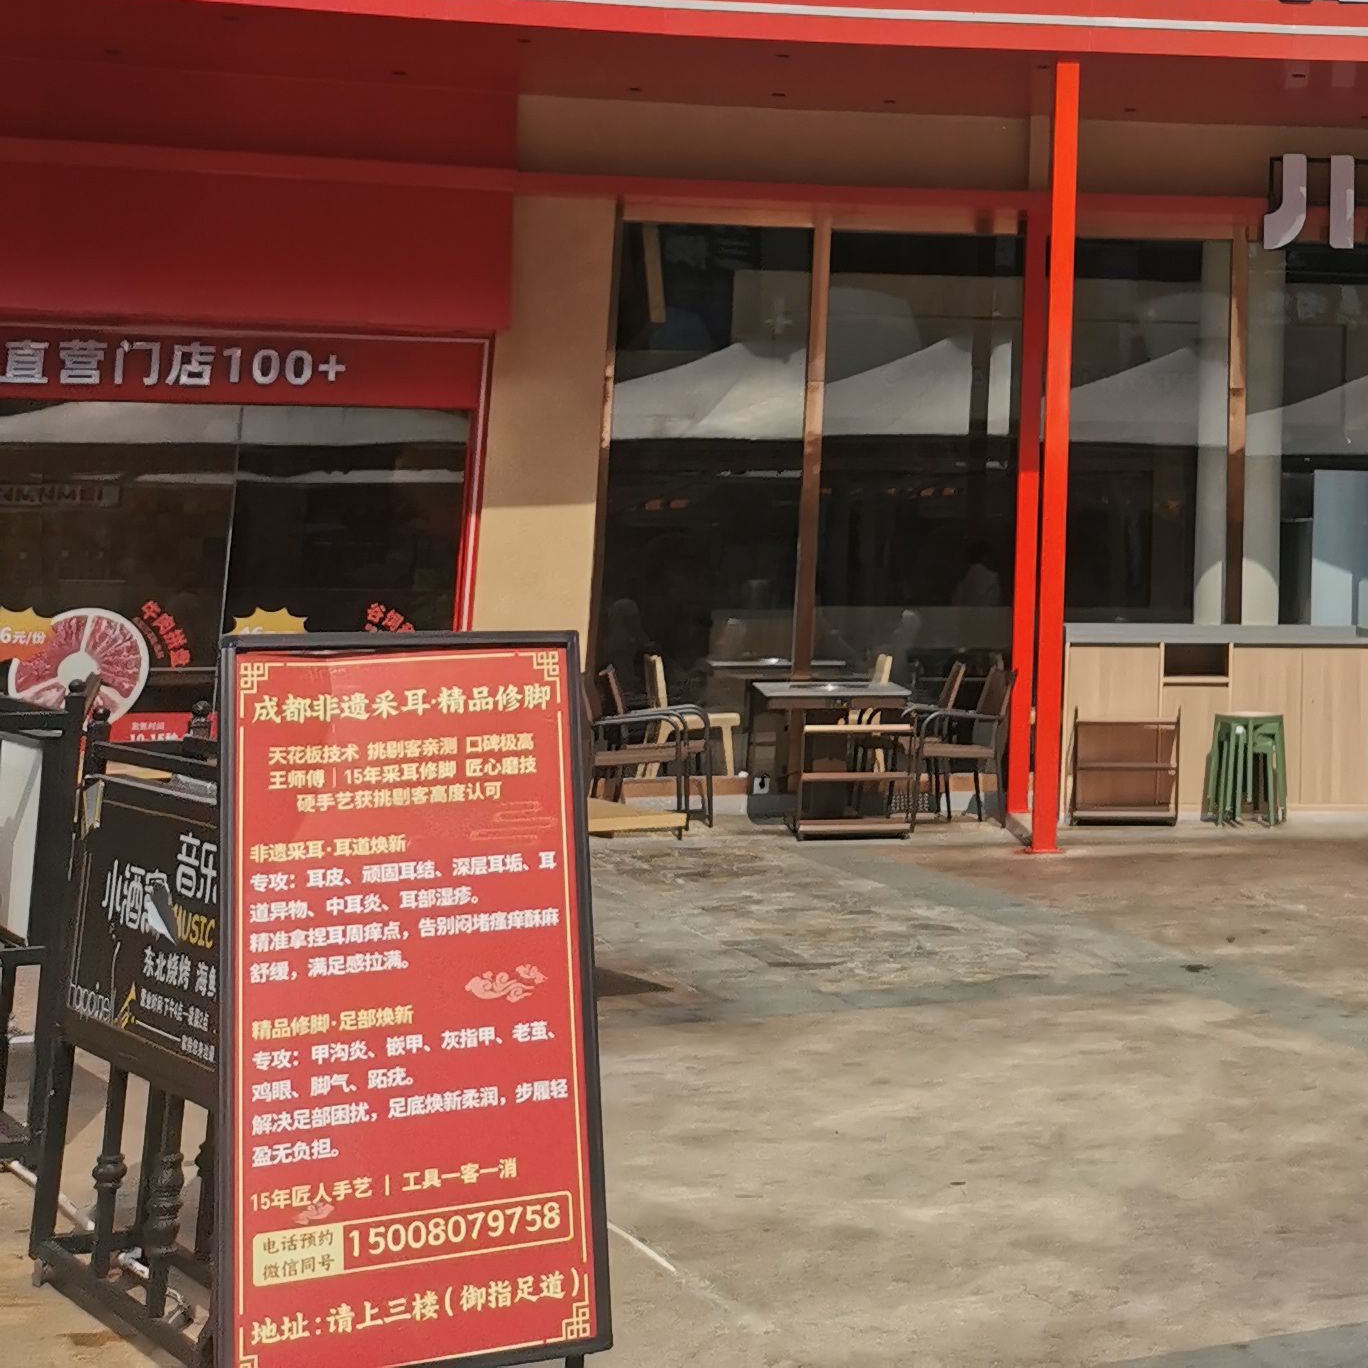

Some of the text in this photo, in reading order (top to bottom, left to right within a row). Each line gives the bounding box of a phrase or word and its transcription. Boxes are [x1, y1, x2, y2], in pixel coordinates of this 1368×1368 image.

[0, 340, 346, 386] 直营门店100+
[252, 683, 551, 724] 成都非遗采耳·精品修脚
[268, 743, 359, 766] 天花板技术
[262, 1232, 334, 1256] 电话预约
[349, 1202, 561, 1257] 15008079758
[262, 1256, 336, 1281] 微信同号
